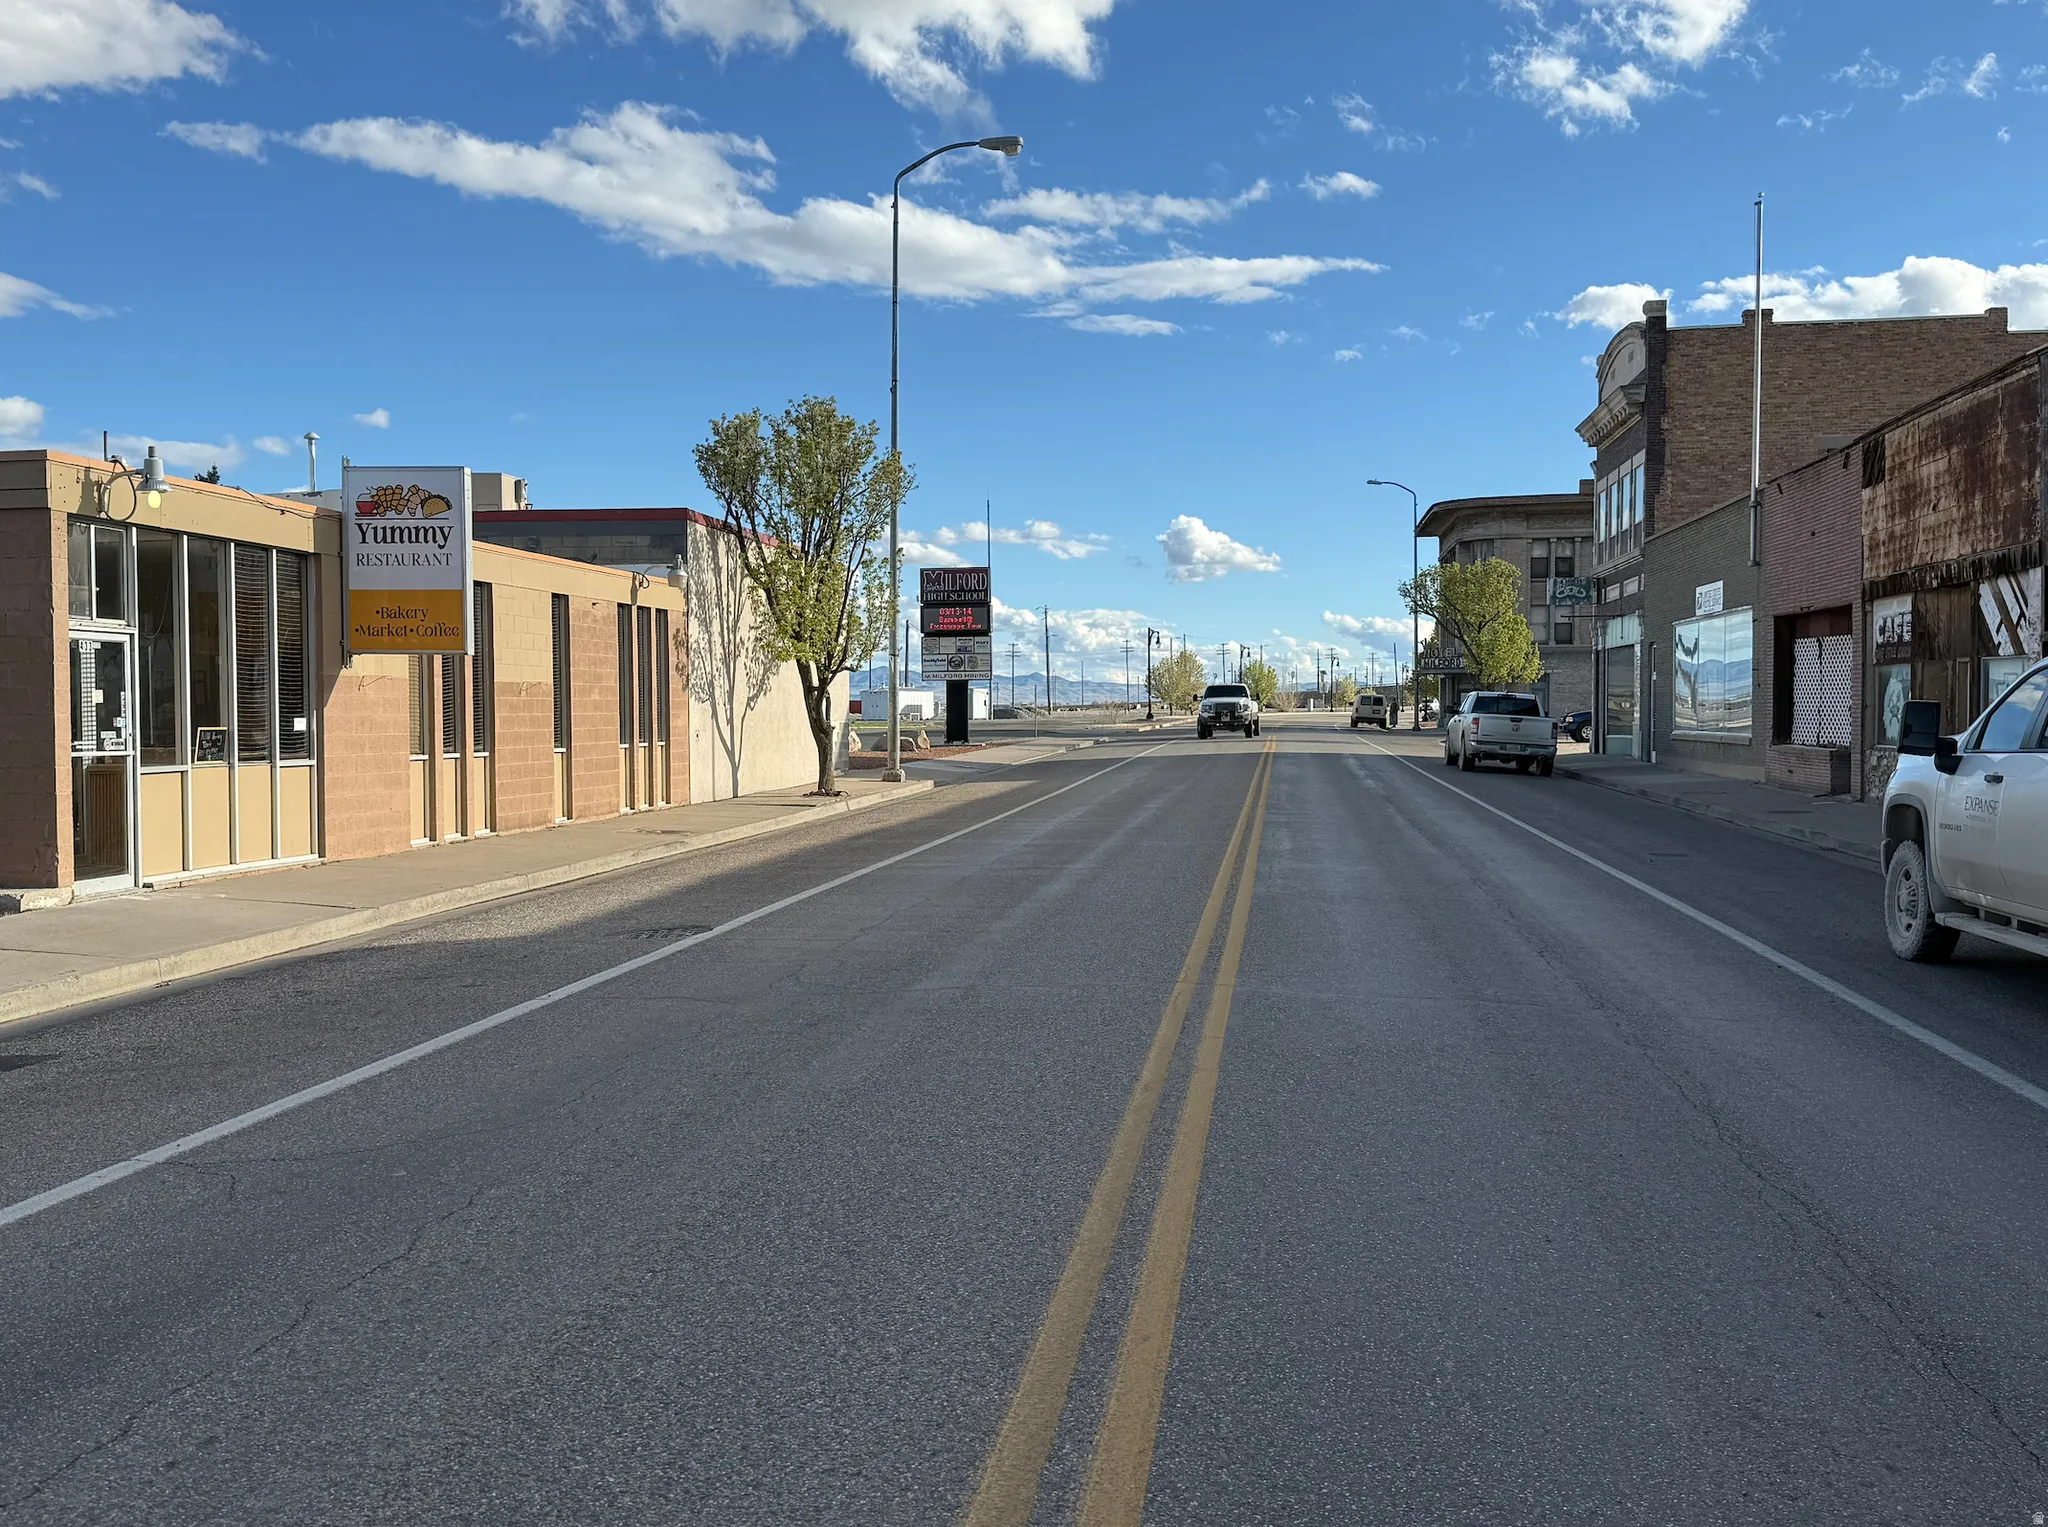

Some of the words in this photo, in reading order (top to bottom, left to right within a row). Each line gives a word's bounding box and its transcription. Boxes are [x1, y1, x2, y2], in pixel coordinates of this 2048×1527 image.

[354, 522, 455, 549] Yummy
[356, 553, 452, 567] RESTAURANT
[924, 571, 988, 592] MILFORD
[924, 592, 947, 601] HIGH
[949, 591, 988, 601] SCHOOL
[416, 622, 460, 637] Coffee
[1876, 611, 1912, 645] CAFE
[1421, 657, 1463, 669] MILFORD
[1964, 795, 2000, 817] EXPANSE
